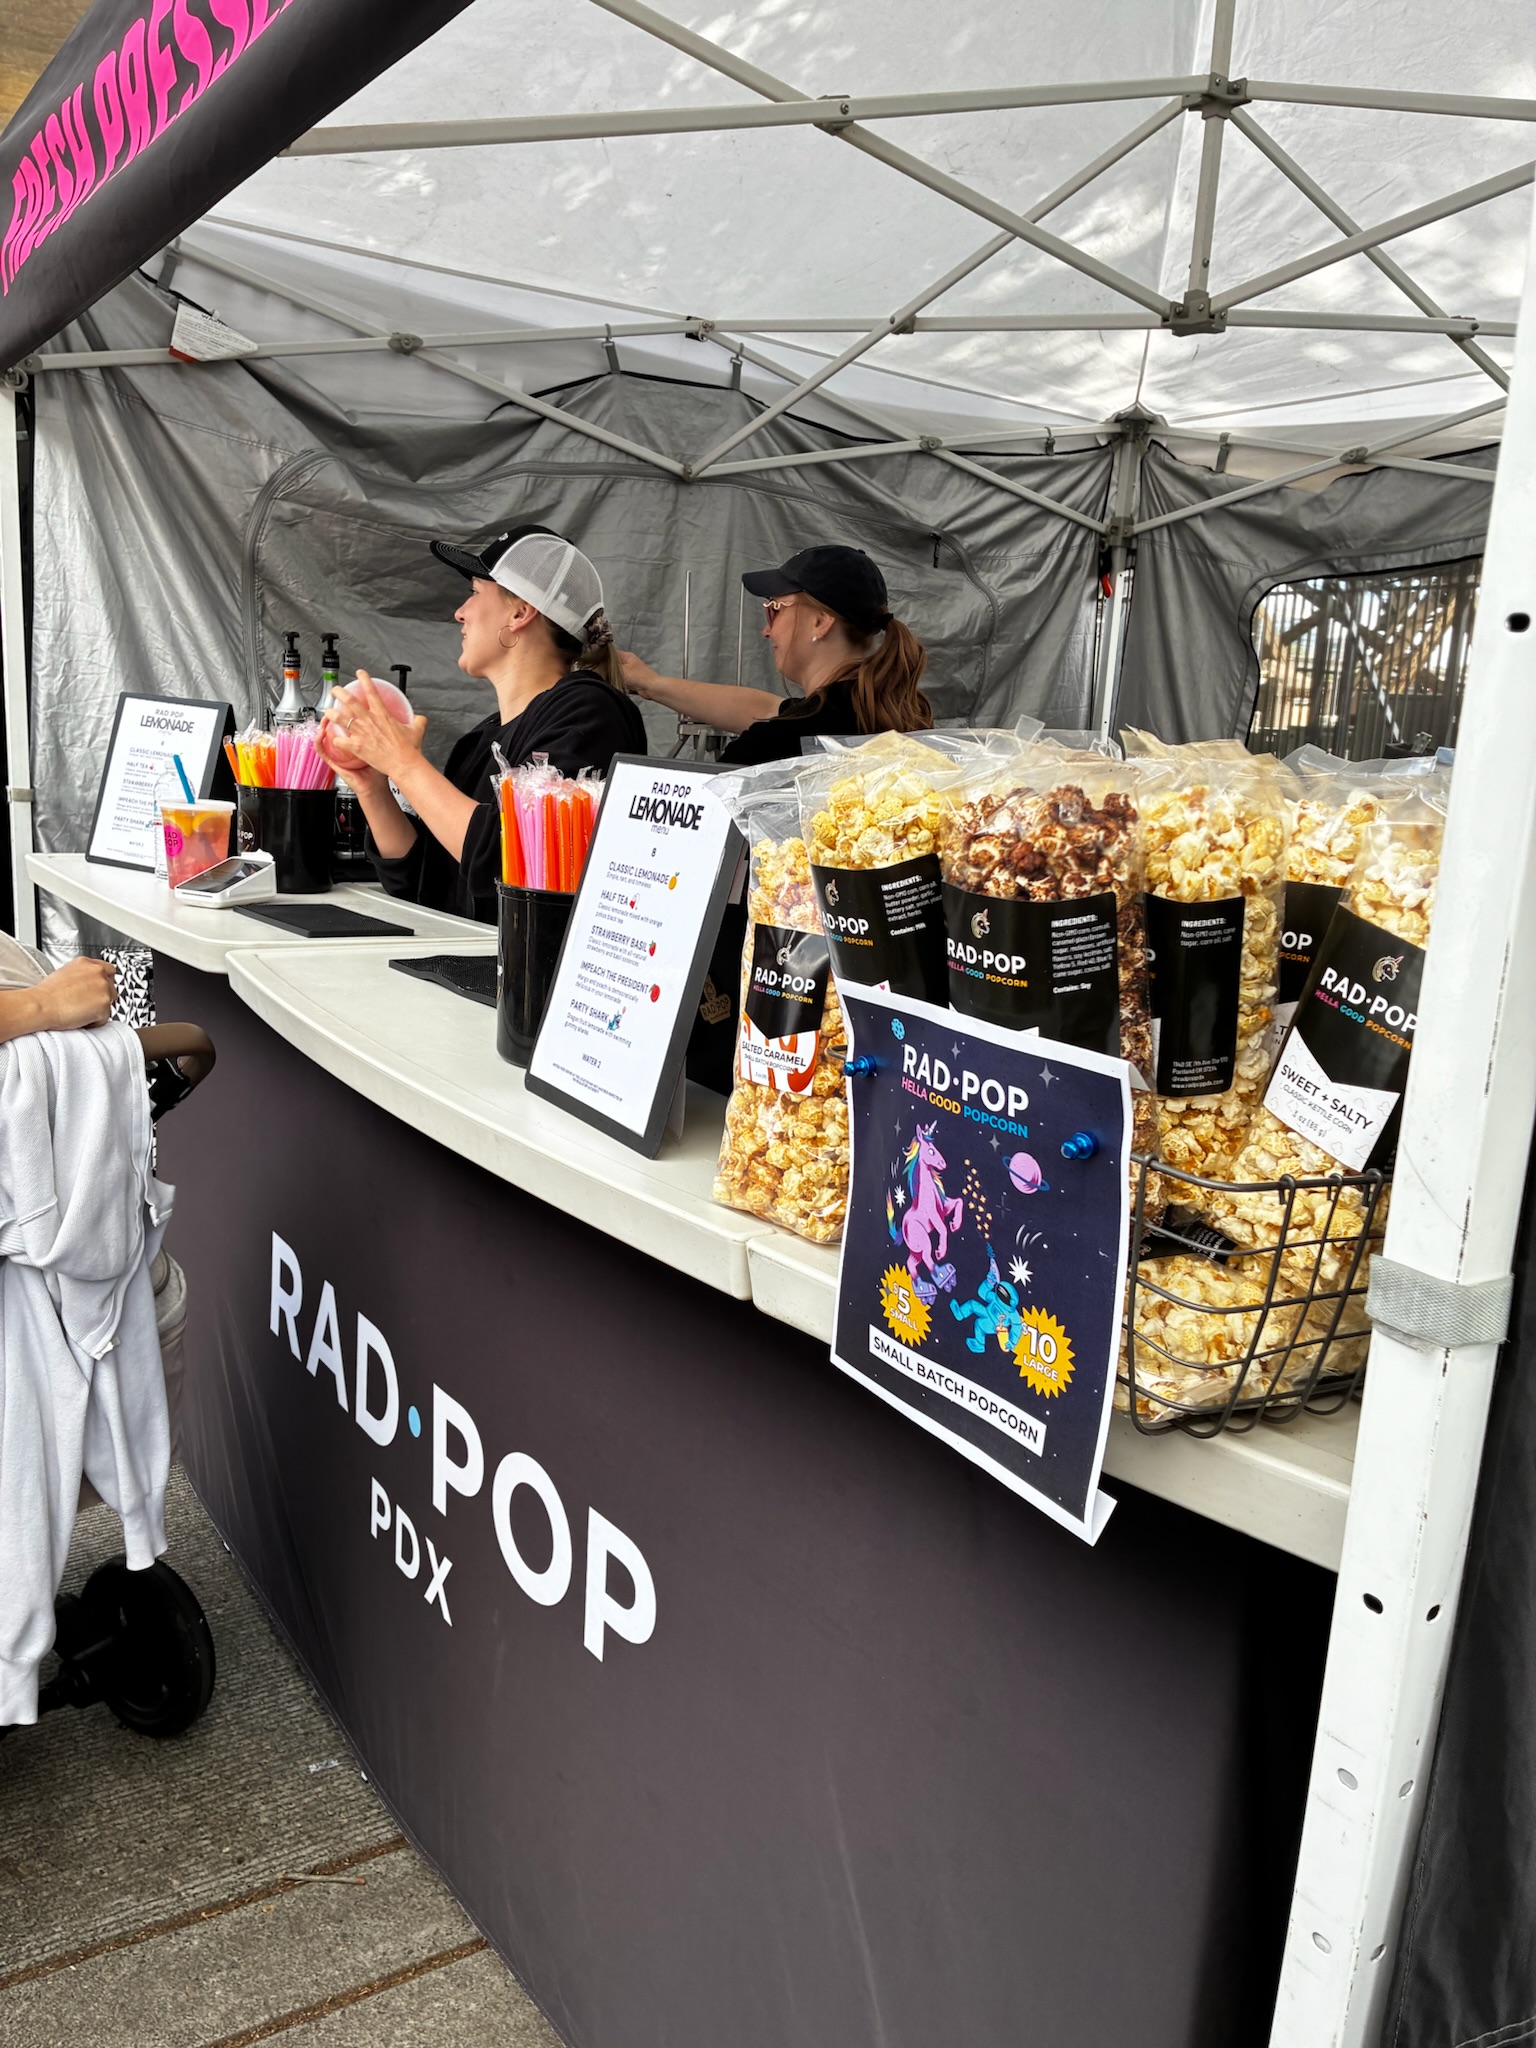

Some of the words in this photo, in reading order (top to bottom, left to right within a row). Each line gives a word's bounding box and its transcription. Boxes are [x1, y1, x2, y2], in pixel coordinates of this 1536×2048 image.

[0, 82, 96, 296] FRESH
[140, 714, 195, 733] LEMONADE
[155, 709, 169, 717] RAD
[170, 710, 184, 718] POP
[651, 781, 671, 796] RAD
[671, 784, 692, 798] POP
[628, 795, 705, 831] LEMONADE
[651, 825, 670, 835] menu
[608, 861, 635, 876] CLASSIC
[634, 868, 670, 885] LEMONADE
[881, 875, 923, 892] INGREDIENTS:
[600, 889, 617, 902] HALF
[617, 894, 629, 906] TEA
[1051, 914, 1099, 929] INGREDIENTS:
[1181, 917, 1227, 928] INGREDIENTS:
[591, 925, 632, 946] STRAWBERRY
[630, 938, 648, 953] BASIL
[843, 936, 874, 947] POPCORN
[580, 960, 606, 978] IMPEACH
[606, 970, 618, 982] THE
[617, 975, 649, 994] PRESIDENT
[947, 960, 964, 973] HELLA
[964, 967, 985, 980] GOOD
[985, 973, 1029, 988] POPCORN
[781, 992, 814, 1005] POPCORN
[570, 999, 590, 1015] PARTY
[589, 1007, 609, 1023] SHARK
[1314, 988, 1340, 1010] HELLA
[1339, 1003, 1366, 1024] GOOD
[1364, 1019, 1413, 1050] POPCORN
[582, 1053, 598, 1067] WATER
[597, 1060, 602, 1069] 2
[742, 1040, 764, 1055] SALTED
[763, 1048, 807, 1068] CARAMEL
[901, 1076, 928, 1101] HELLA
[928, 1091, 961, 1115] GOOD
[963, 1106, 1029, 1139] POPCORN
[1280, 1064, 1321, 1097] SWEET
[1321, 1094, 1329, 1102] +
[1330, 1098, 1374, 1130] SALTY
[1307, 1101, 1334, 1121] KETTLE
[1332, 1117, 1354, 1135] CORN
[890, 1307, 919, 1331] SMALL
[1023, 1354, 1059, 1382] LARGE
[873, 1336, 914, 1371] SMALL
[916, 1363, 964, 1399] BATCH
[968, 1389, 1038, 1444] POPCORN
[371, 1476, 453, 1627] PDX
